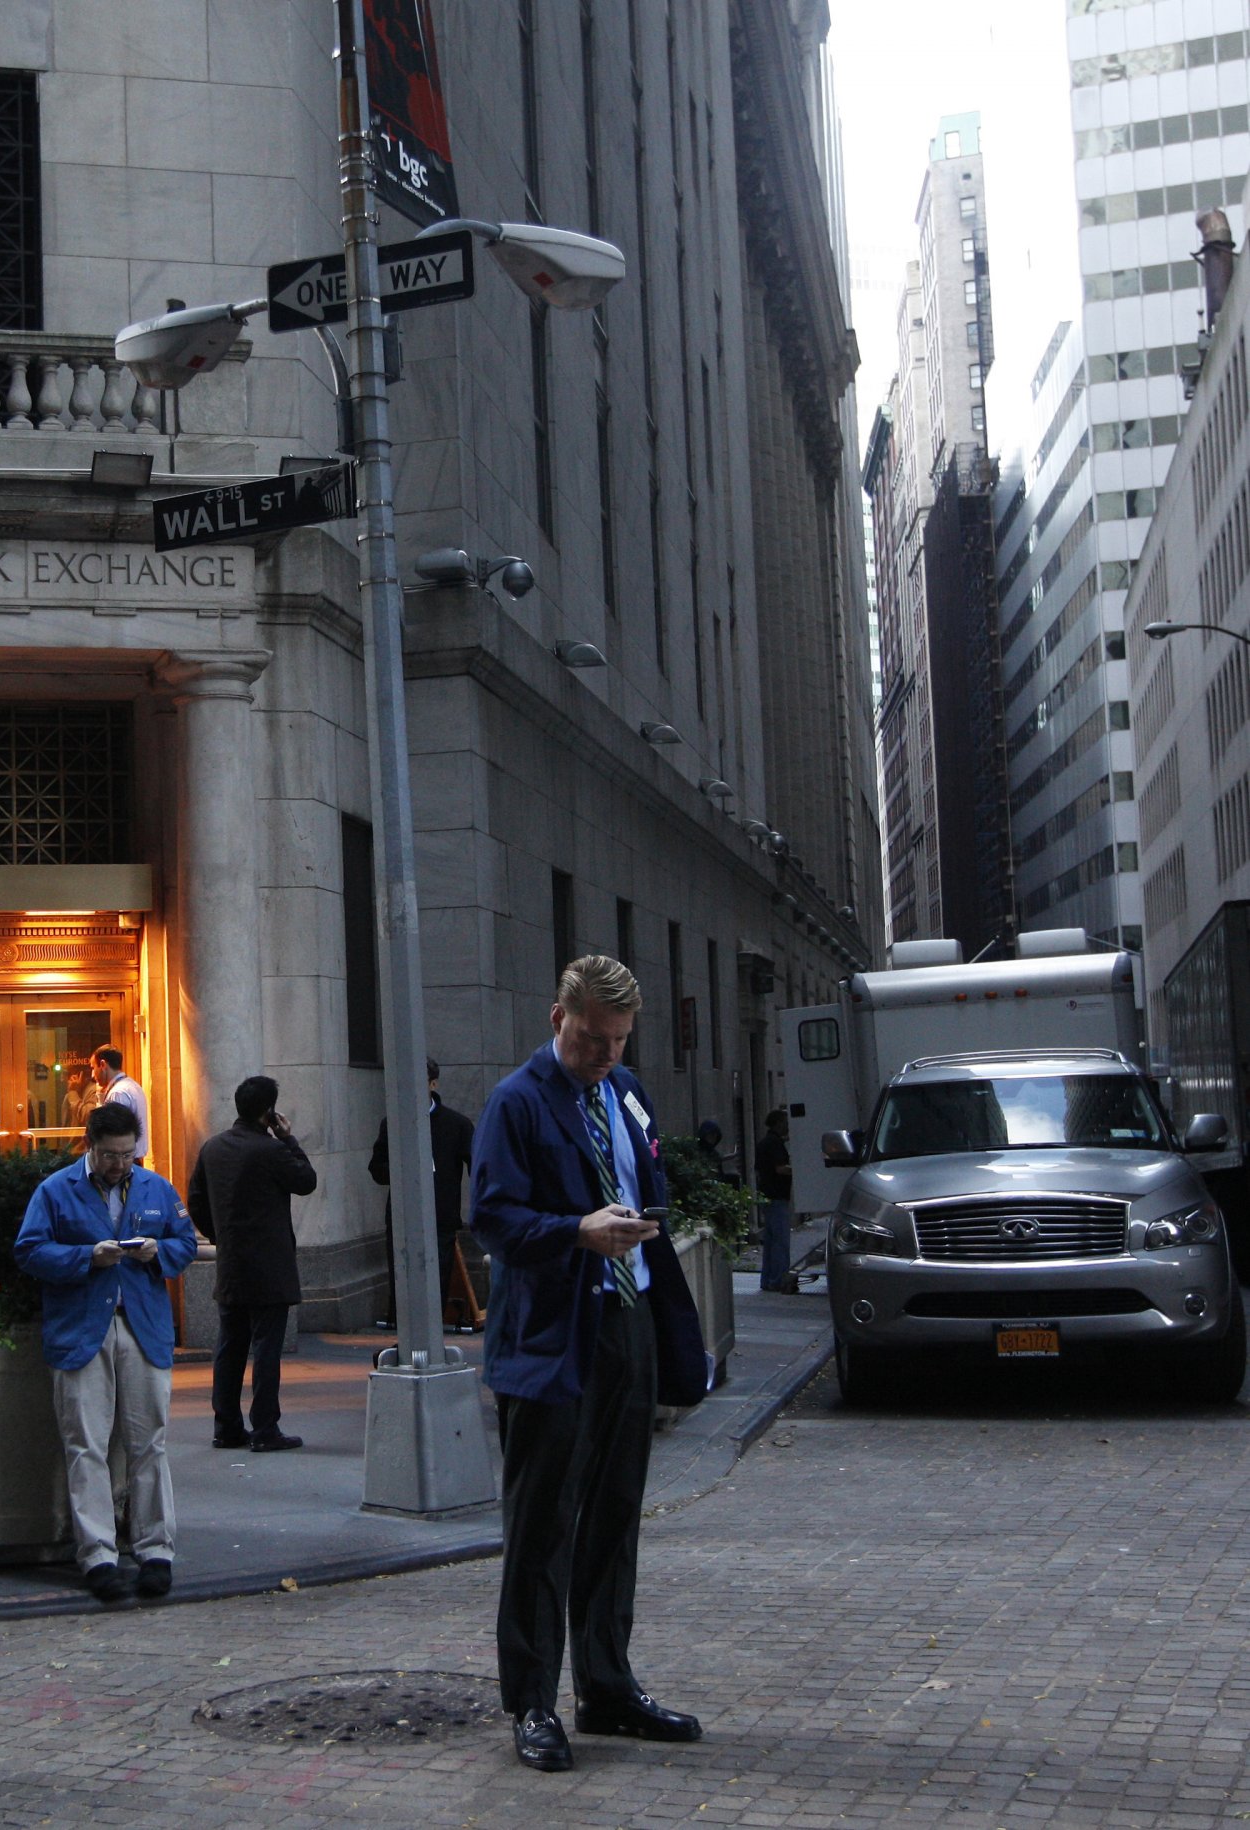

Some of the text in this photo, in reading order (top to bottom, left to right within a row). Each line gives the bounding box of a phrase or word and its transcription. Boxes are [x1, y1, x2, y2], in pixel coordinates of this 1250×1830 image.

[398, 140, 429, 189] bgc
[296, 255, 447, 307] ONE WAY
[162, 491, 286, 541] WALL ST
[216, 486, 244, 502] 9-15
[32, 551, 237, 588] EXCHANGE
